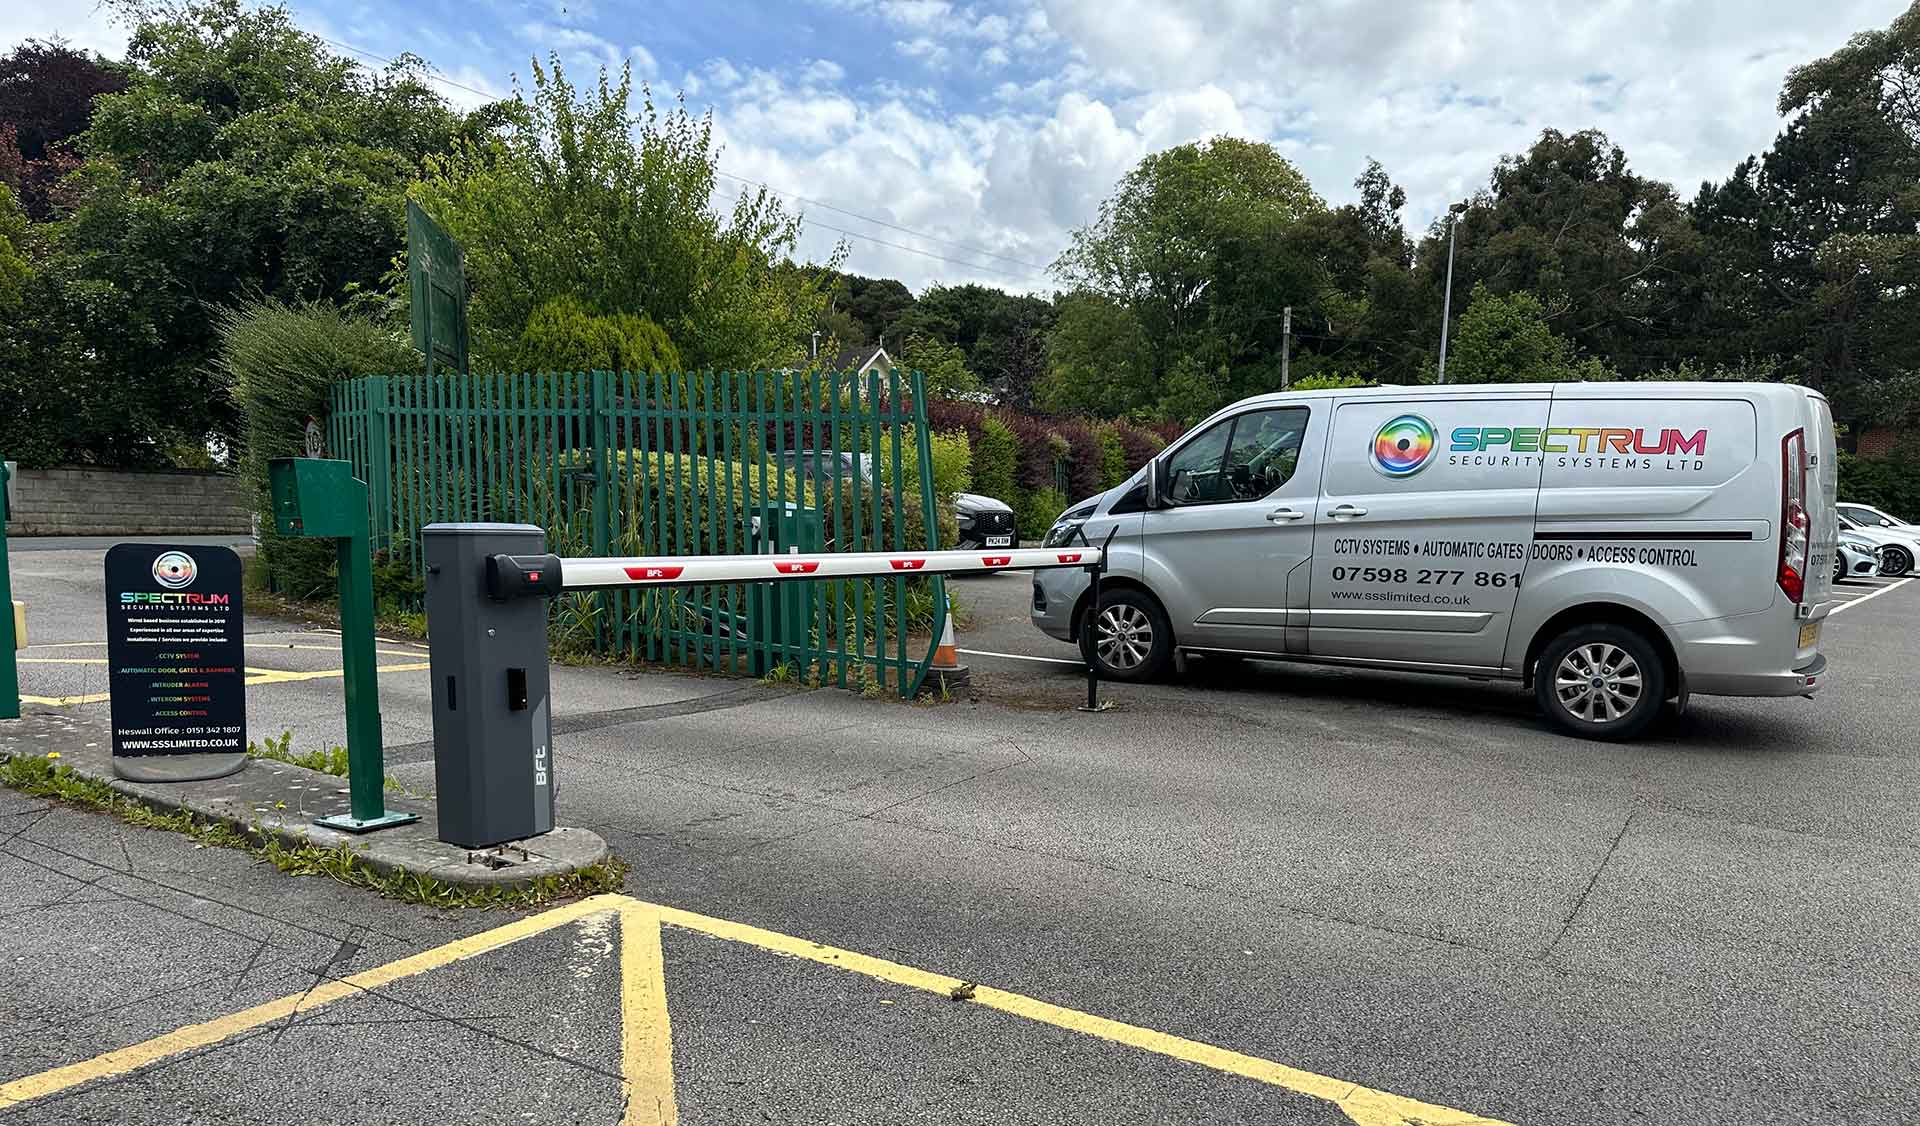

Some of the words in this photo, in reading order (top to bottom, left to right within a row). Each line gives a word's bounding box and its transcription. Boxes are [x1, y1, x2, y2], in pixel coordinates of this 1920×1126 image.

[1449, 427, 1708, 456] SPECTRUM
[1449, 455, 1544, 467] SECURITY
[1558, 457, 1651, 470] SYSTEMS
[1666, 459, 1704, 471] LTD
[1334, 538, 1362, 555] CCTV
[1362, 539, 1410, 556] SYSTEMS
[1422, 541, 1485, 559] AUTOMATIC
[1487, 543, 1524, 559] GATES
[1532, 543, 1574, 561] DOORS
[1586, 546, 1636, 564] ACCESS
[1638, 547, 1698, 567] CONTROL
[1332, 566, 1408, 583] 07598
[1416, 569, 1465, 586] 277
[1474, 571, 1521, 588] 861
[120, 592, 229, 605] SPECTRUM
[1331, 591, 1472, 606] www.ssslimited.co.uk
[154, 727, 180, 735] Office
[206, 726, 220, 734] 342
[122, 738, 239, 750] WWW.SSSLIMITED.CO.UK
